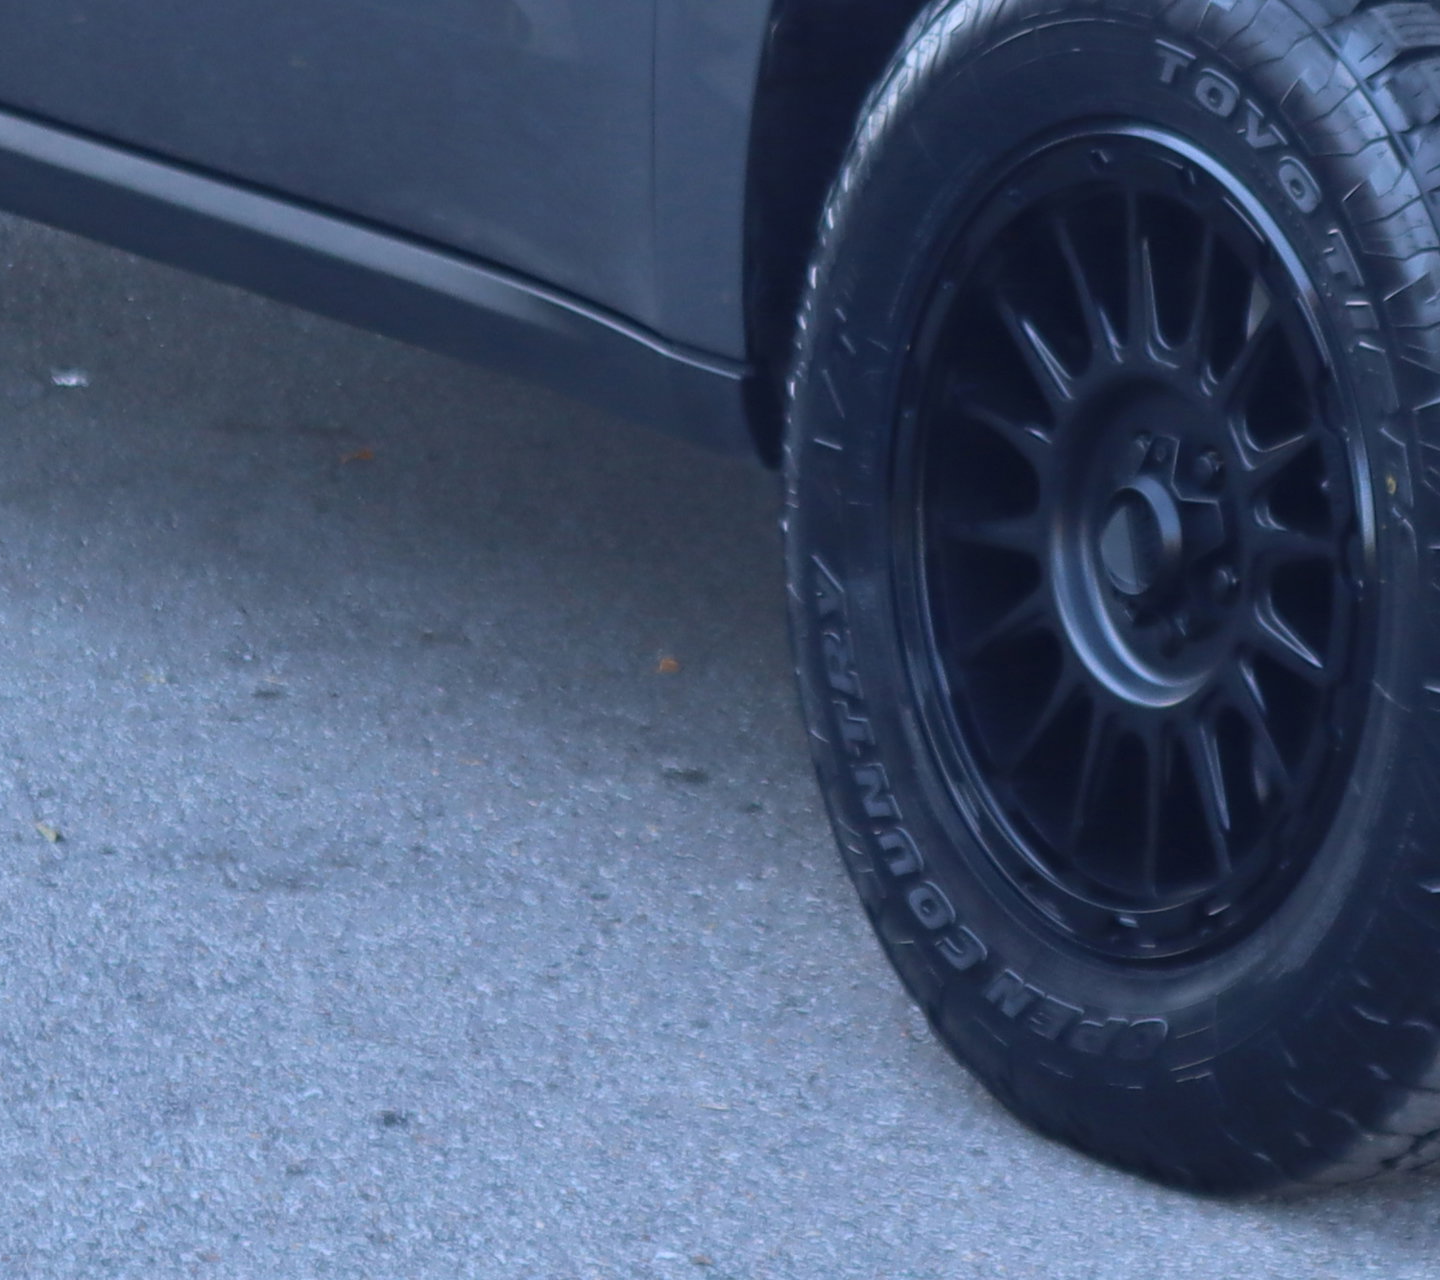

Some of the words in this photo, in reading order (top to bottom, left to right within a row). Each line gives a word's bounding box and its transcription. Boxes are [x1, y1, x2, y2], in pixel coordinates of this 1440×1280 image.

[1153, 38, 1323, 214] TOYO
[810, 552, 990, 974] COUNTRY
[982, 967, 1171, 1060] OPEN
